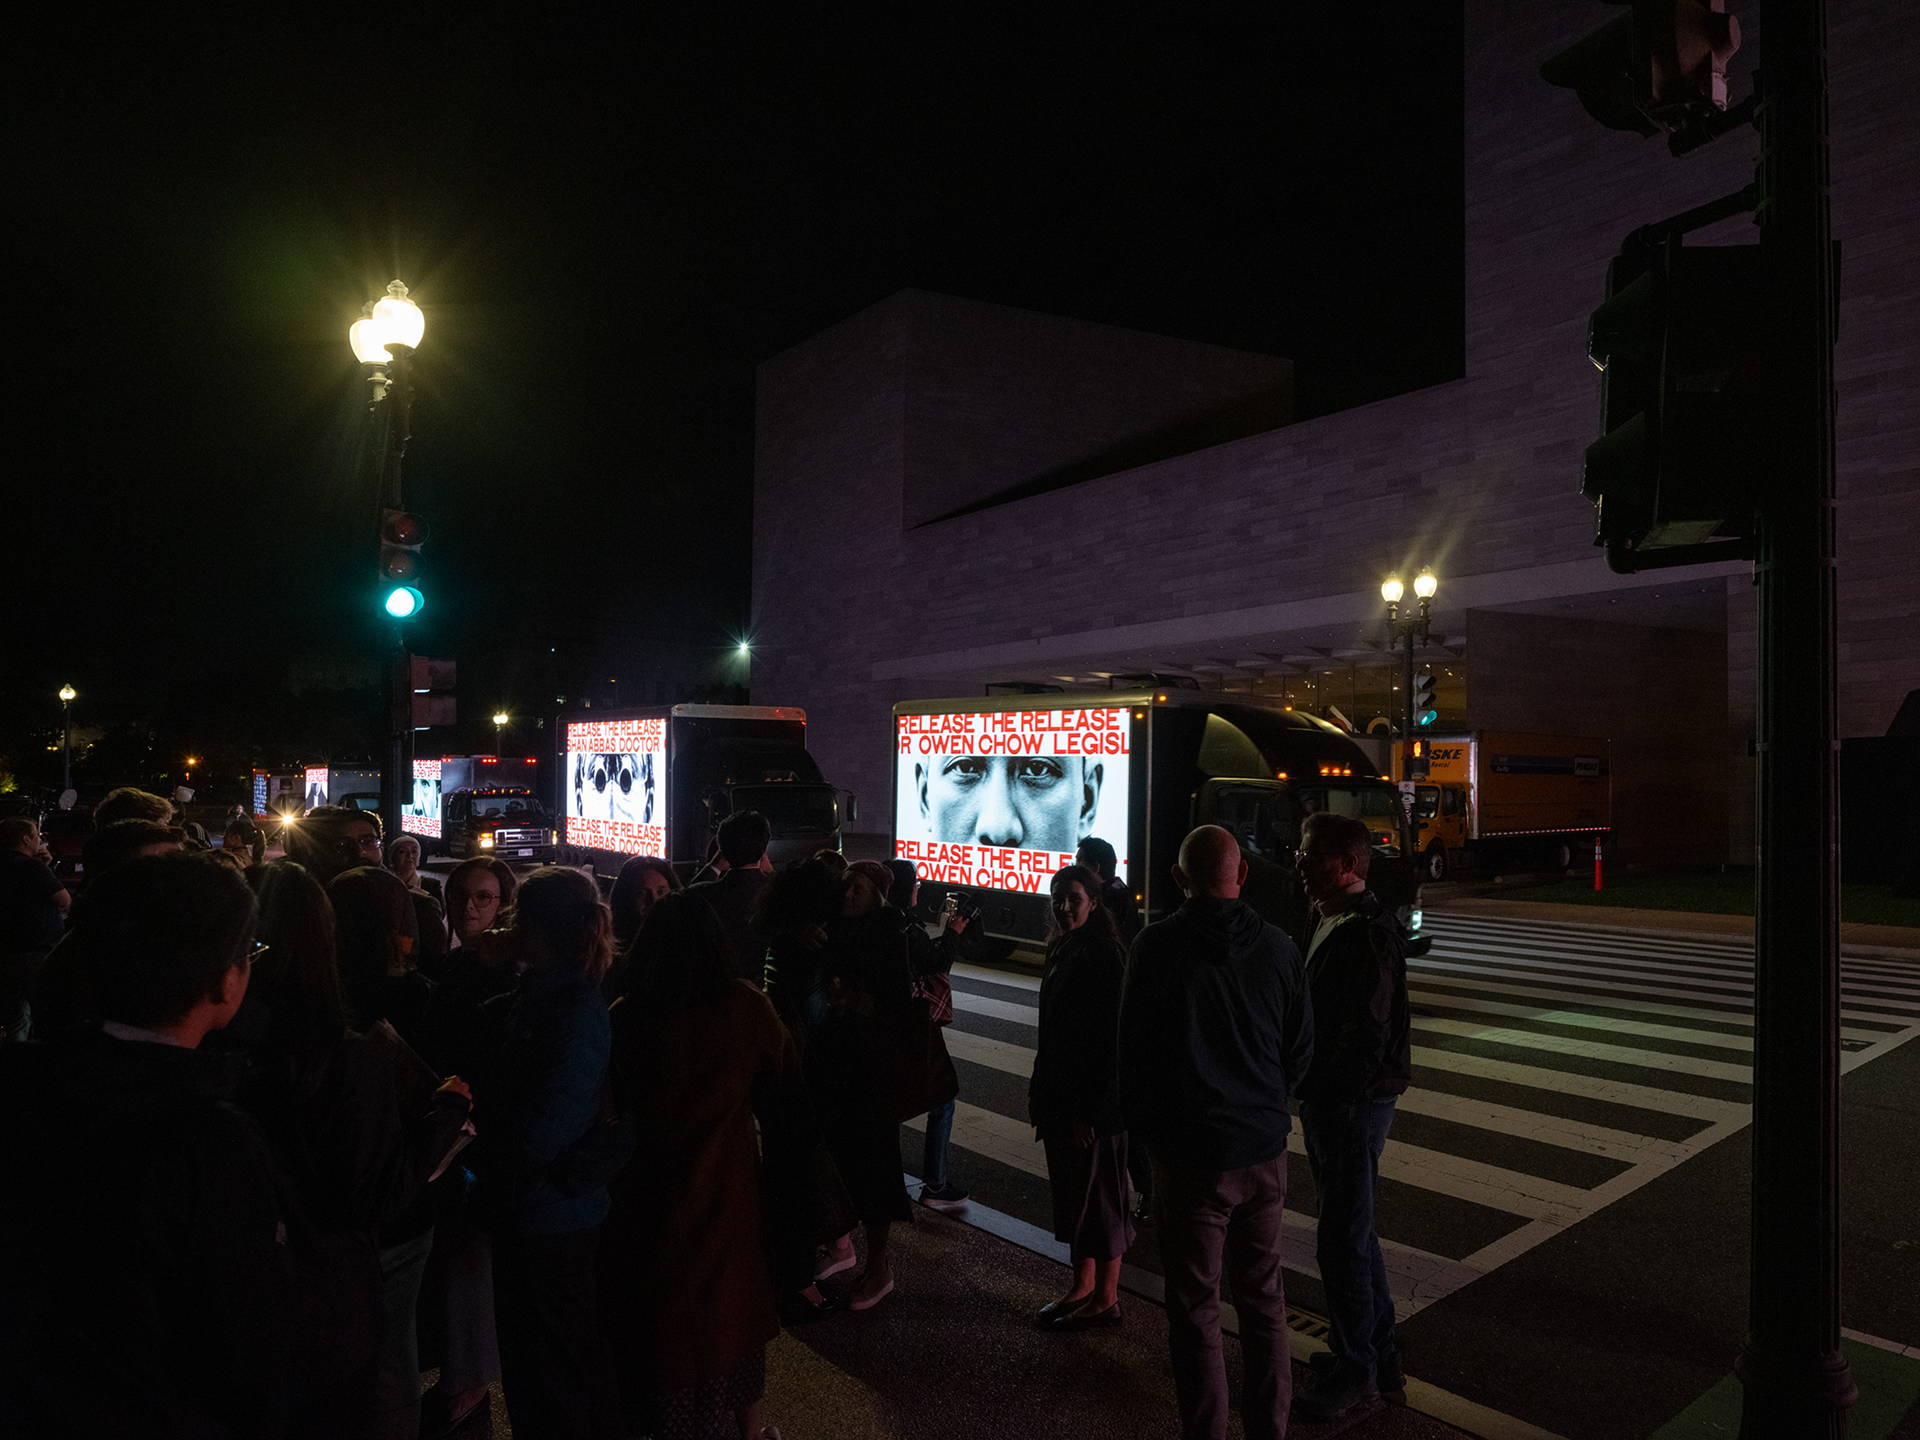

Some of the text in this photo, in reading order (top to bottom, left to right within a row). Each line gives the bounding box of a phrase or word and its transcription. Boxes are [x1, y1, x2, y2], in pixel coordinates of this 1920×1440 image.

[567, 719, 662, 737] RELEASE THE RELEASE
[898, 708, 1120, 734] RELEASE THE RELEASE
[588, 737, 616, 752] ABBAS
[619, 736, 660, 752] DOCTOR
[919, 735, 974, 754] OWEN
[979, 733, 1044, 754] CHOW
[1054, 732, 1129, 754] LEGISL
[1576, 762, 1598, 771] PENSKE
[567, 816, 662, 842] RELEASE THE RELEASE
[588, 834, 616, 851] ABBAS
[619, 838, 660, 857] DOCTOR
[896, 839, 1072, 874] RELEASE THE RELE
[917, 862, 1042, 893] OWEN CHOW
